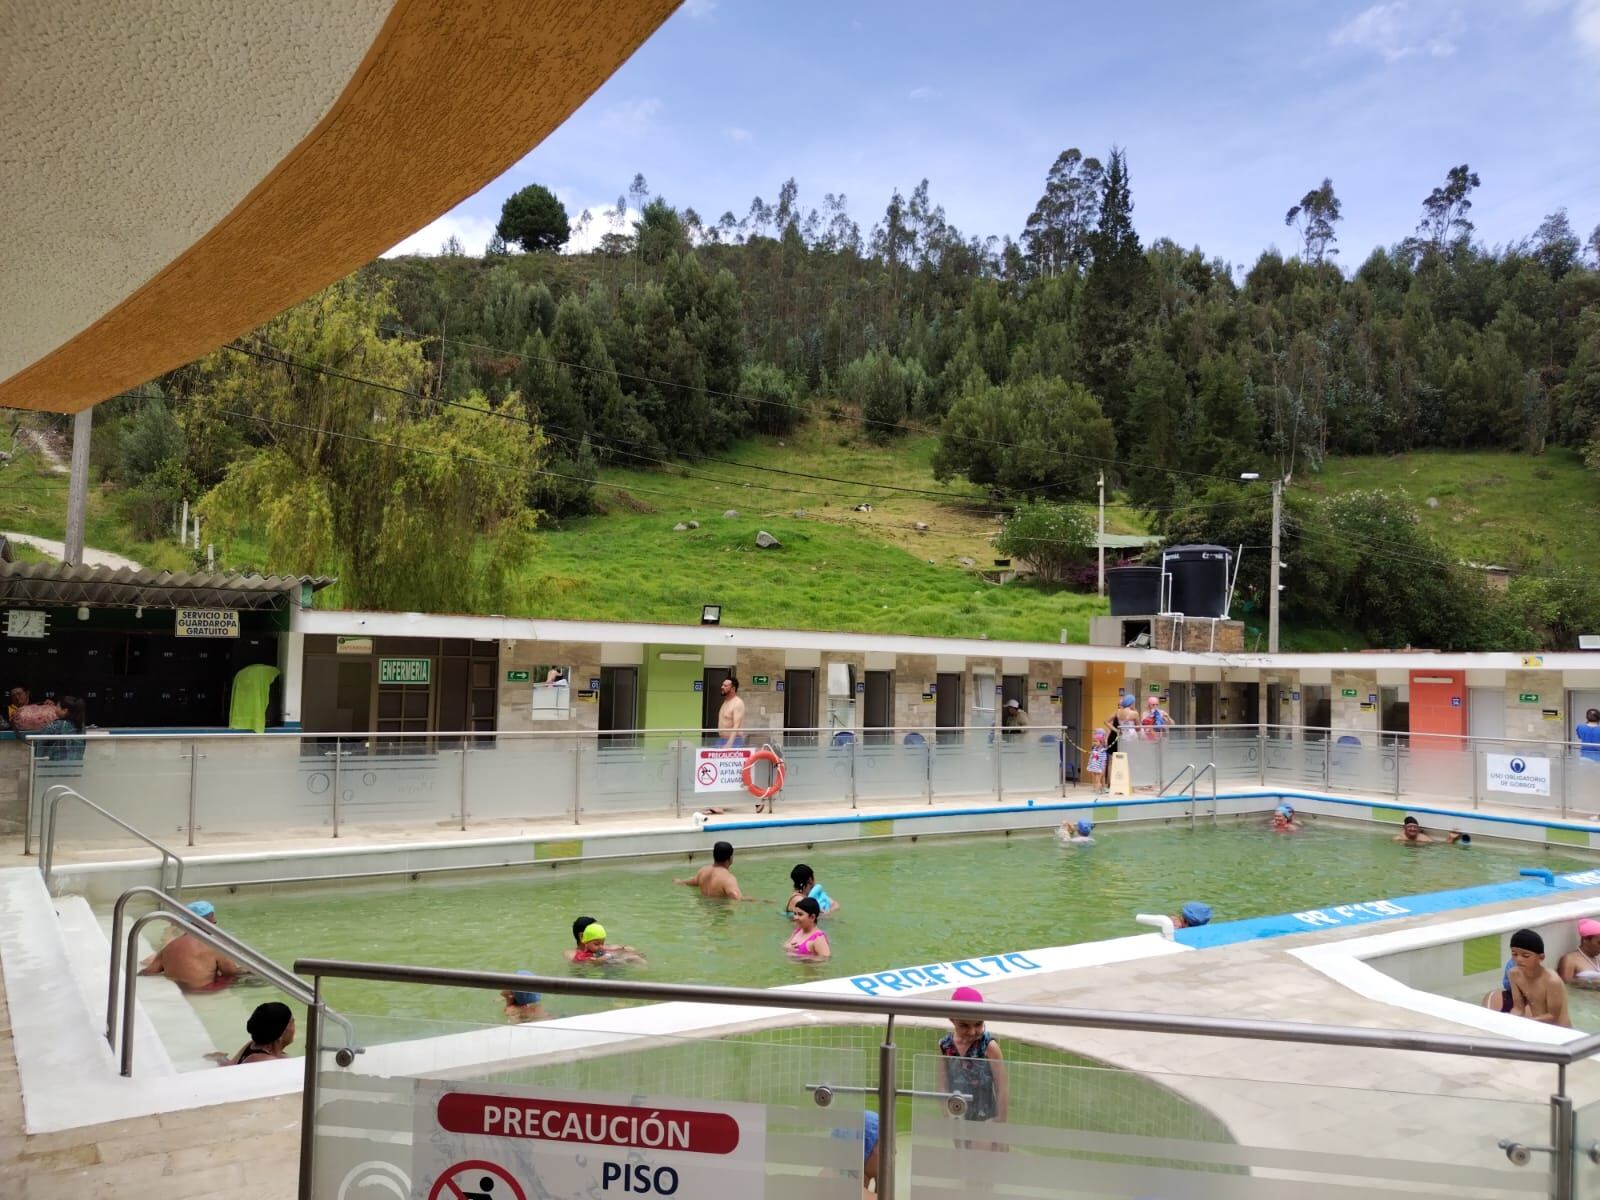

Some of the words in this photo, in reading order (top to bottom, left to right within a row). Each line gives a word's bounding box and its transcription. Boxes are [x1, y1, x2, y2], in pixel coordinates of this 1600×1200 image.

[182, 611, 220, 620] SERVICIO
[223, 612, 234, 620] DE
[178, 619, 237, 628] GUARDAROPA
[186, 627, 229, 635] GRATUITO
[382, 661, 428, 681] ENFERMERIA
[1504, 774, 1546, 783] OBLIGATORIO
[483, 1104, 690, 1149] PRECAUCIÓN
[602, 1161, 679, 1196] PISO
